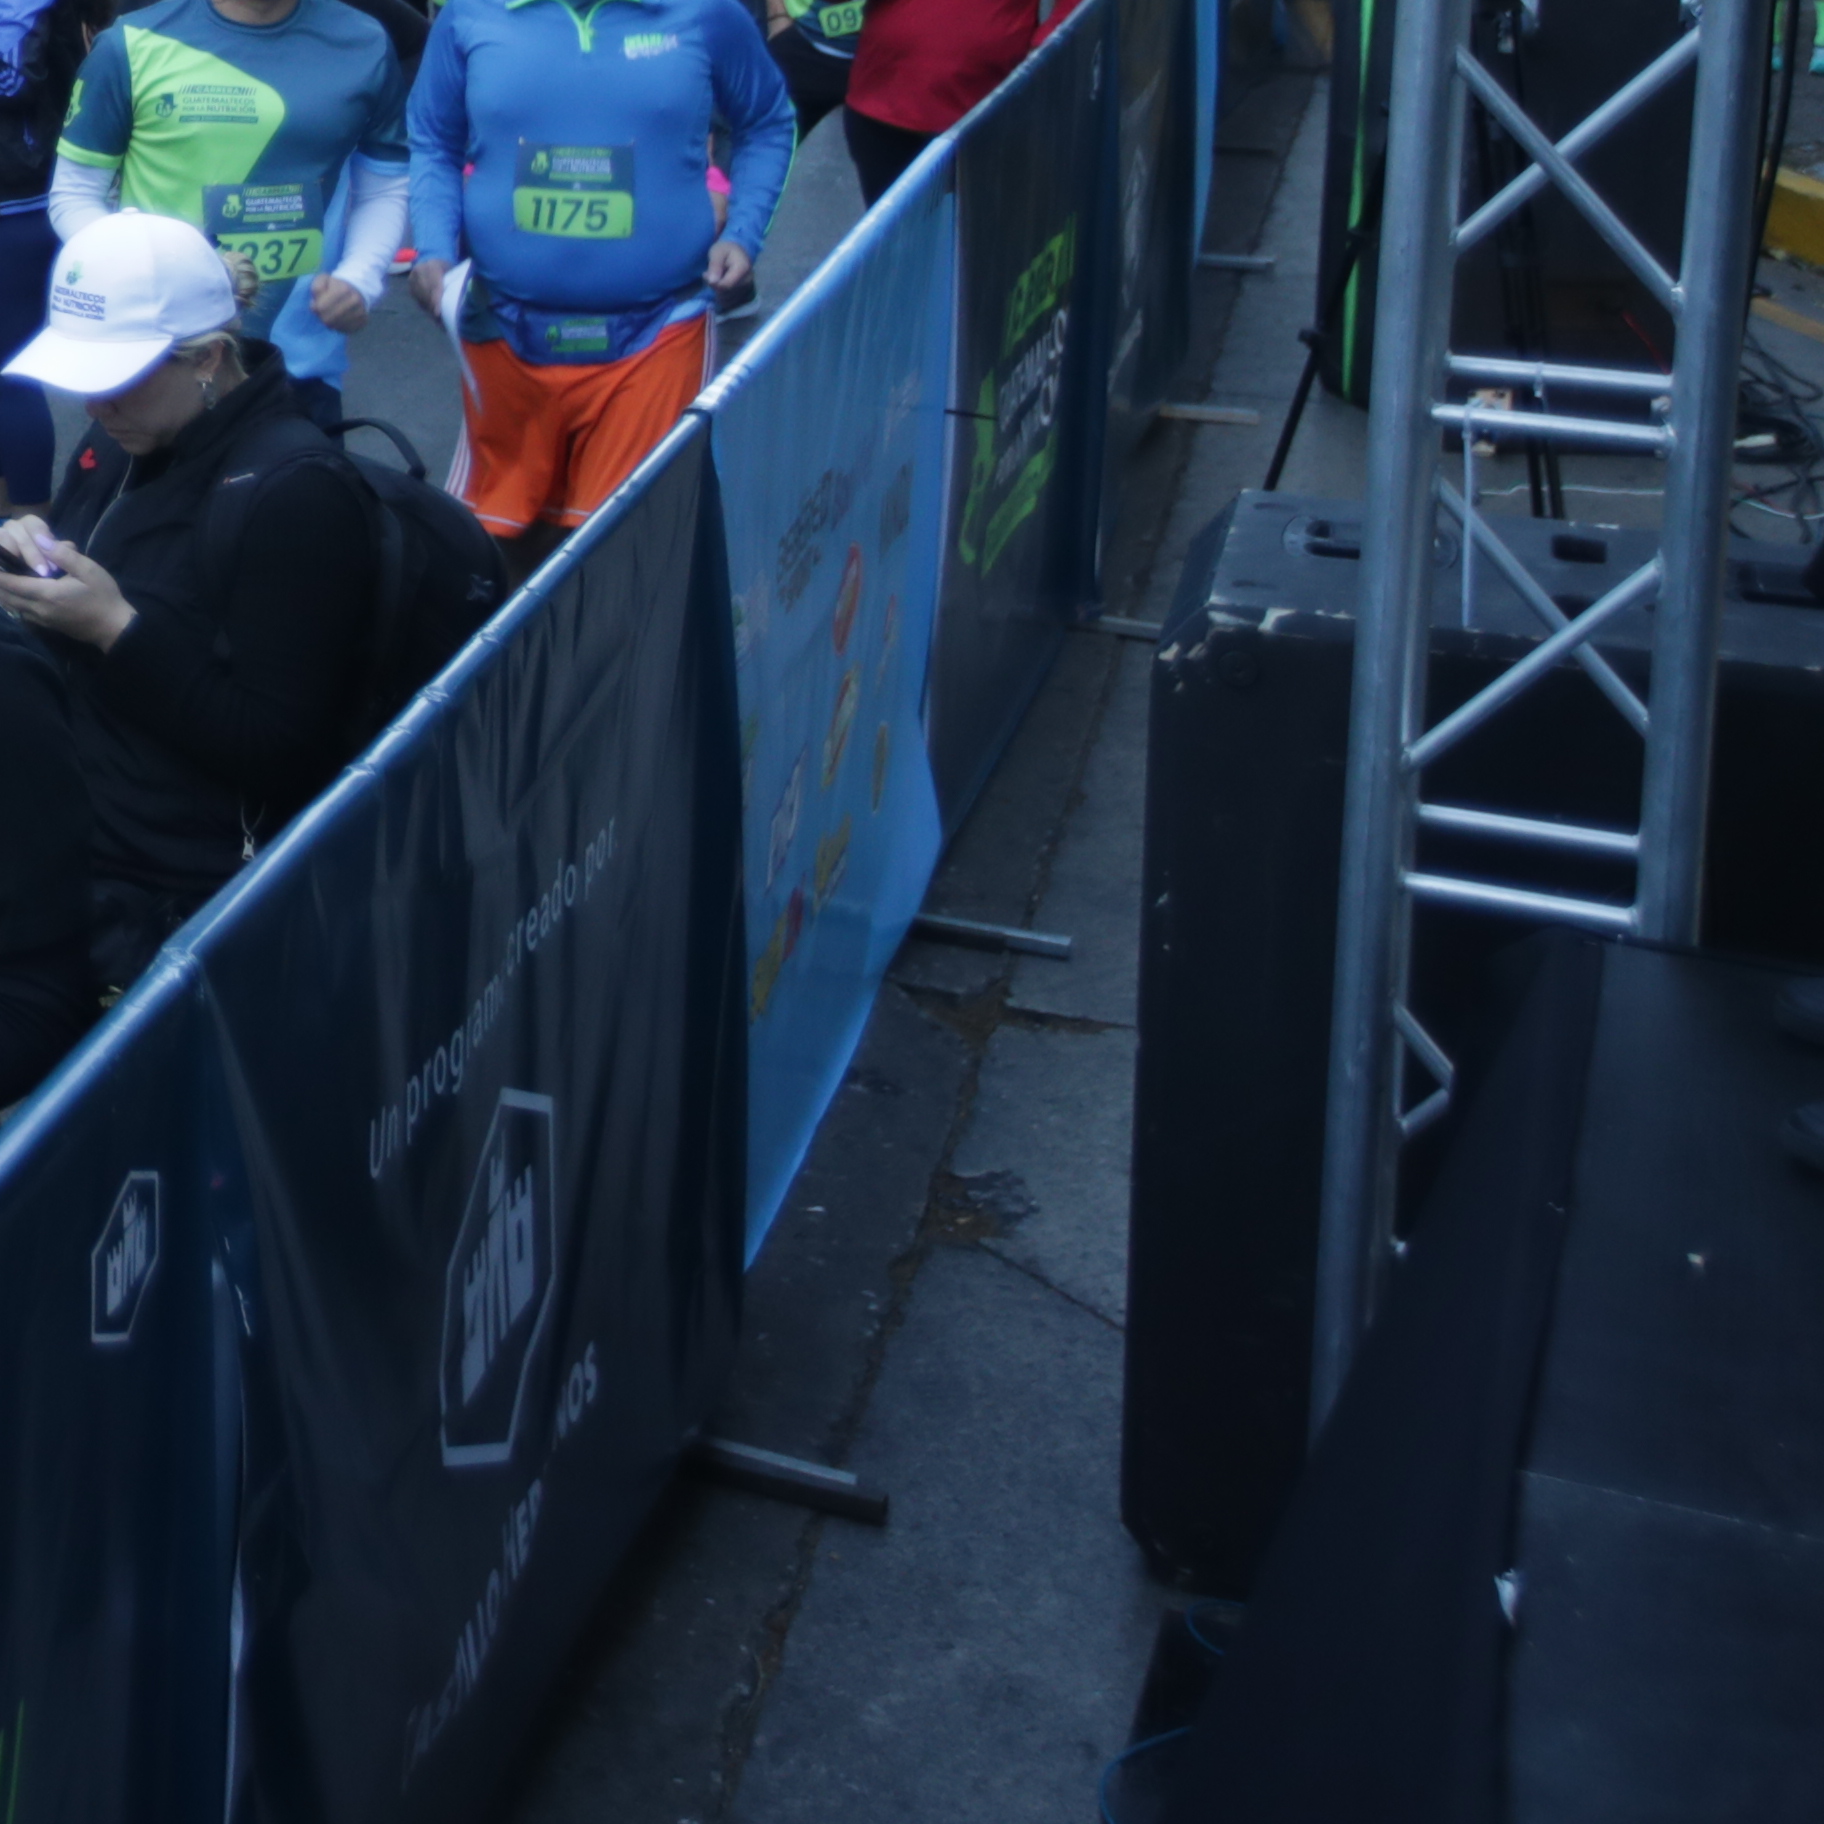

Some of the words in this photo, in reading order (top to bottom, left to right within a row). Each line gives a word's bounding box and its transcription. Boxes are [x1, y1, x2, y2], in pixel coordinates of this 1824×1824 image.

[531, 197, 610, 233] 1175
[368, 1104, 399, 1180] Un
[506, 857, 577, 977] creado
